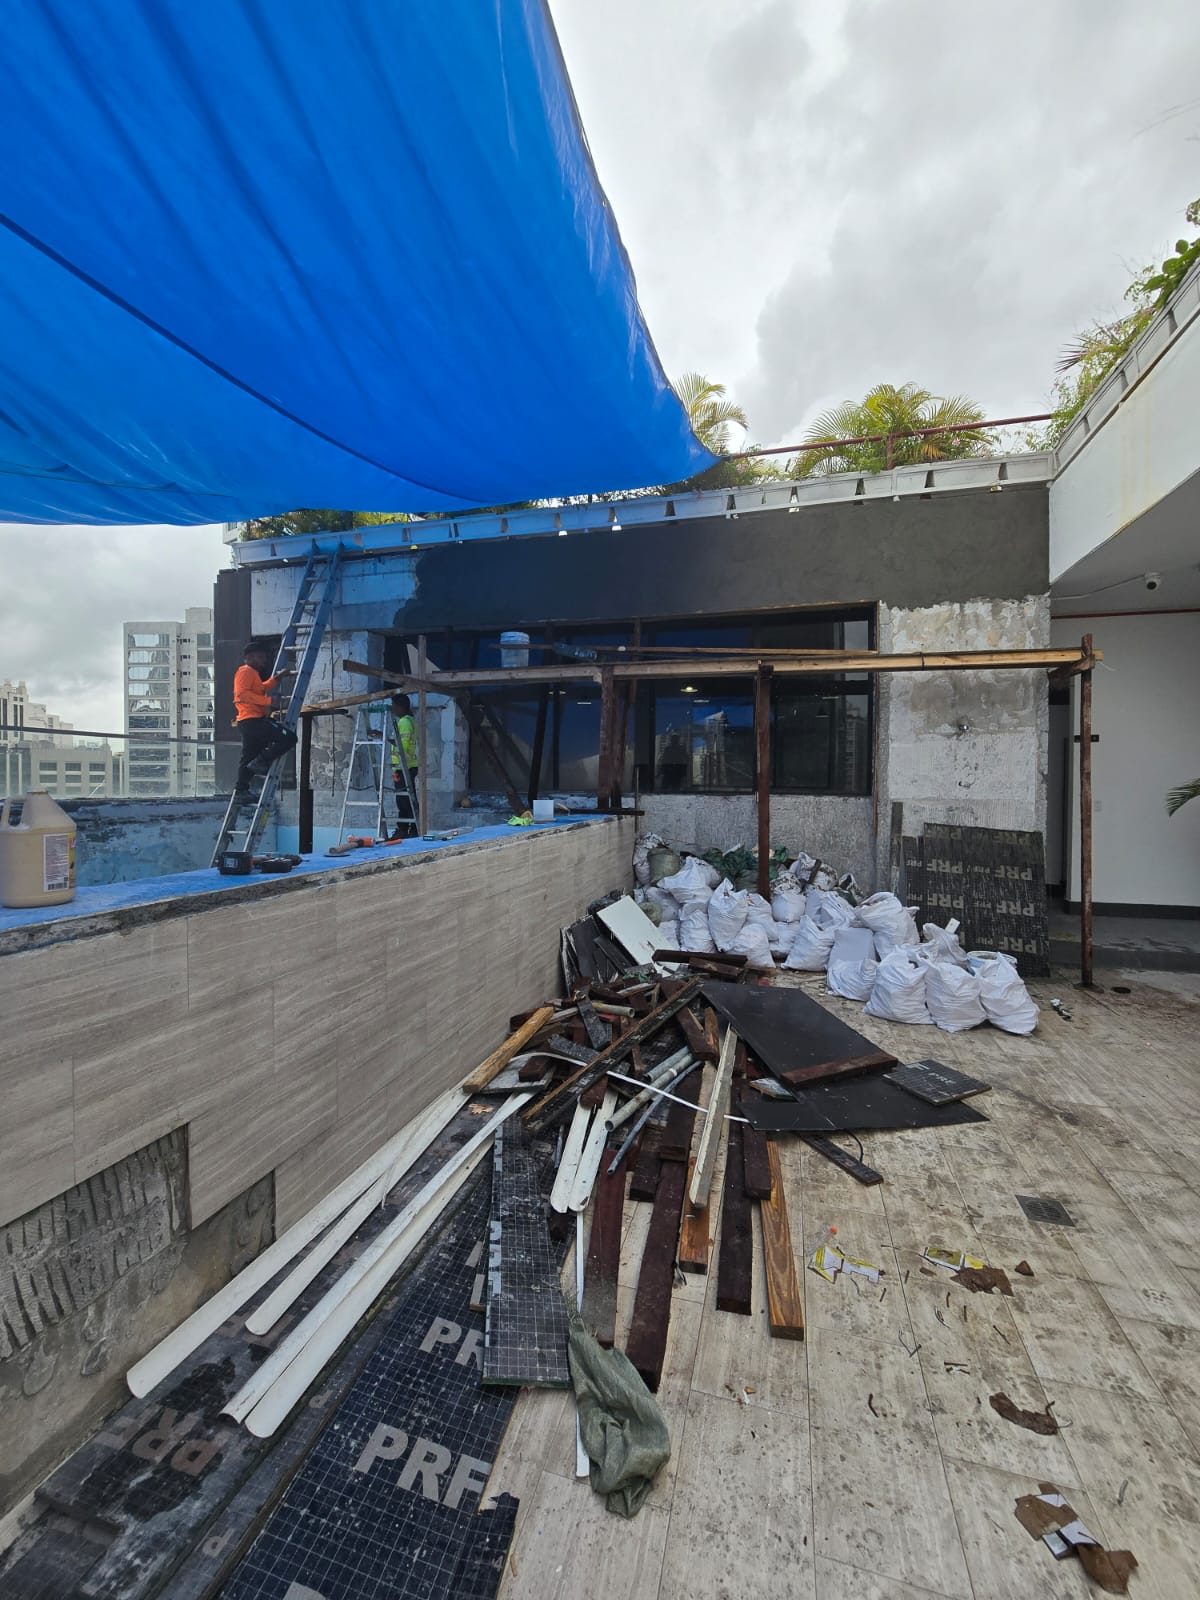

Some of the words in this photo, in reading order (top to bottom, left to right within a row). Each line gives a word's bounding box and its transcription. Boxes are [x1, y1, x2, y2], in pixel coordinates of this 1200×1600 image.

[926, 859, 963, 874] PRF
[995, 865, 1033, 880] PRF
[927, 893, 964, 909] PRF
[996, 900, 1035, 916] PRF
[999, 936, 1037, 954] PRF
[419, 1316, 485, 1371] PR
[95, 1405, 231, 1477] PRF
[354, 1422, 493, 1510] PRF
